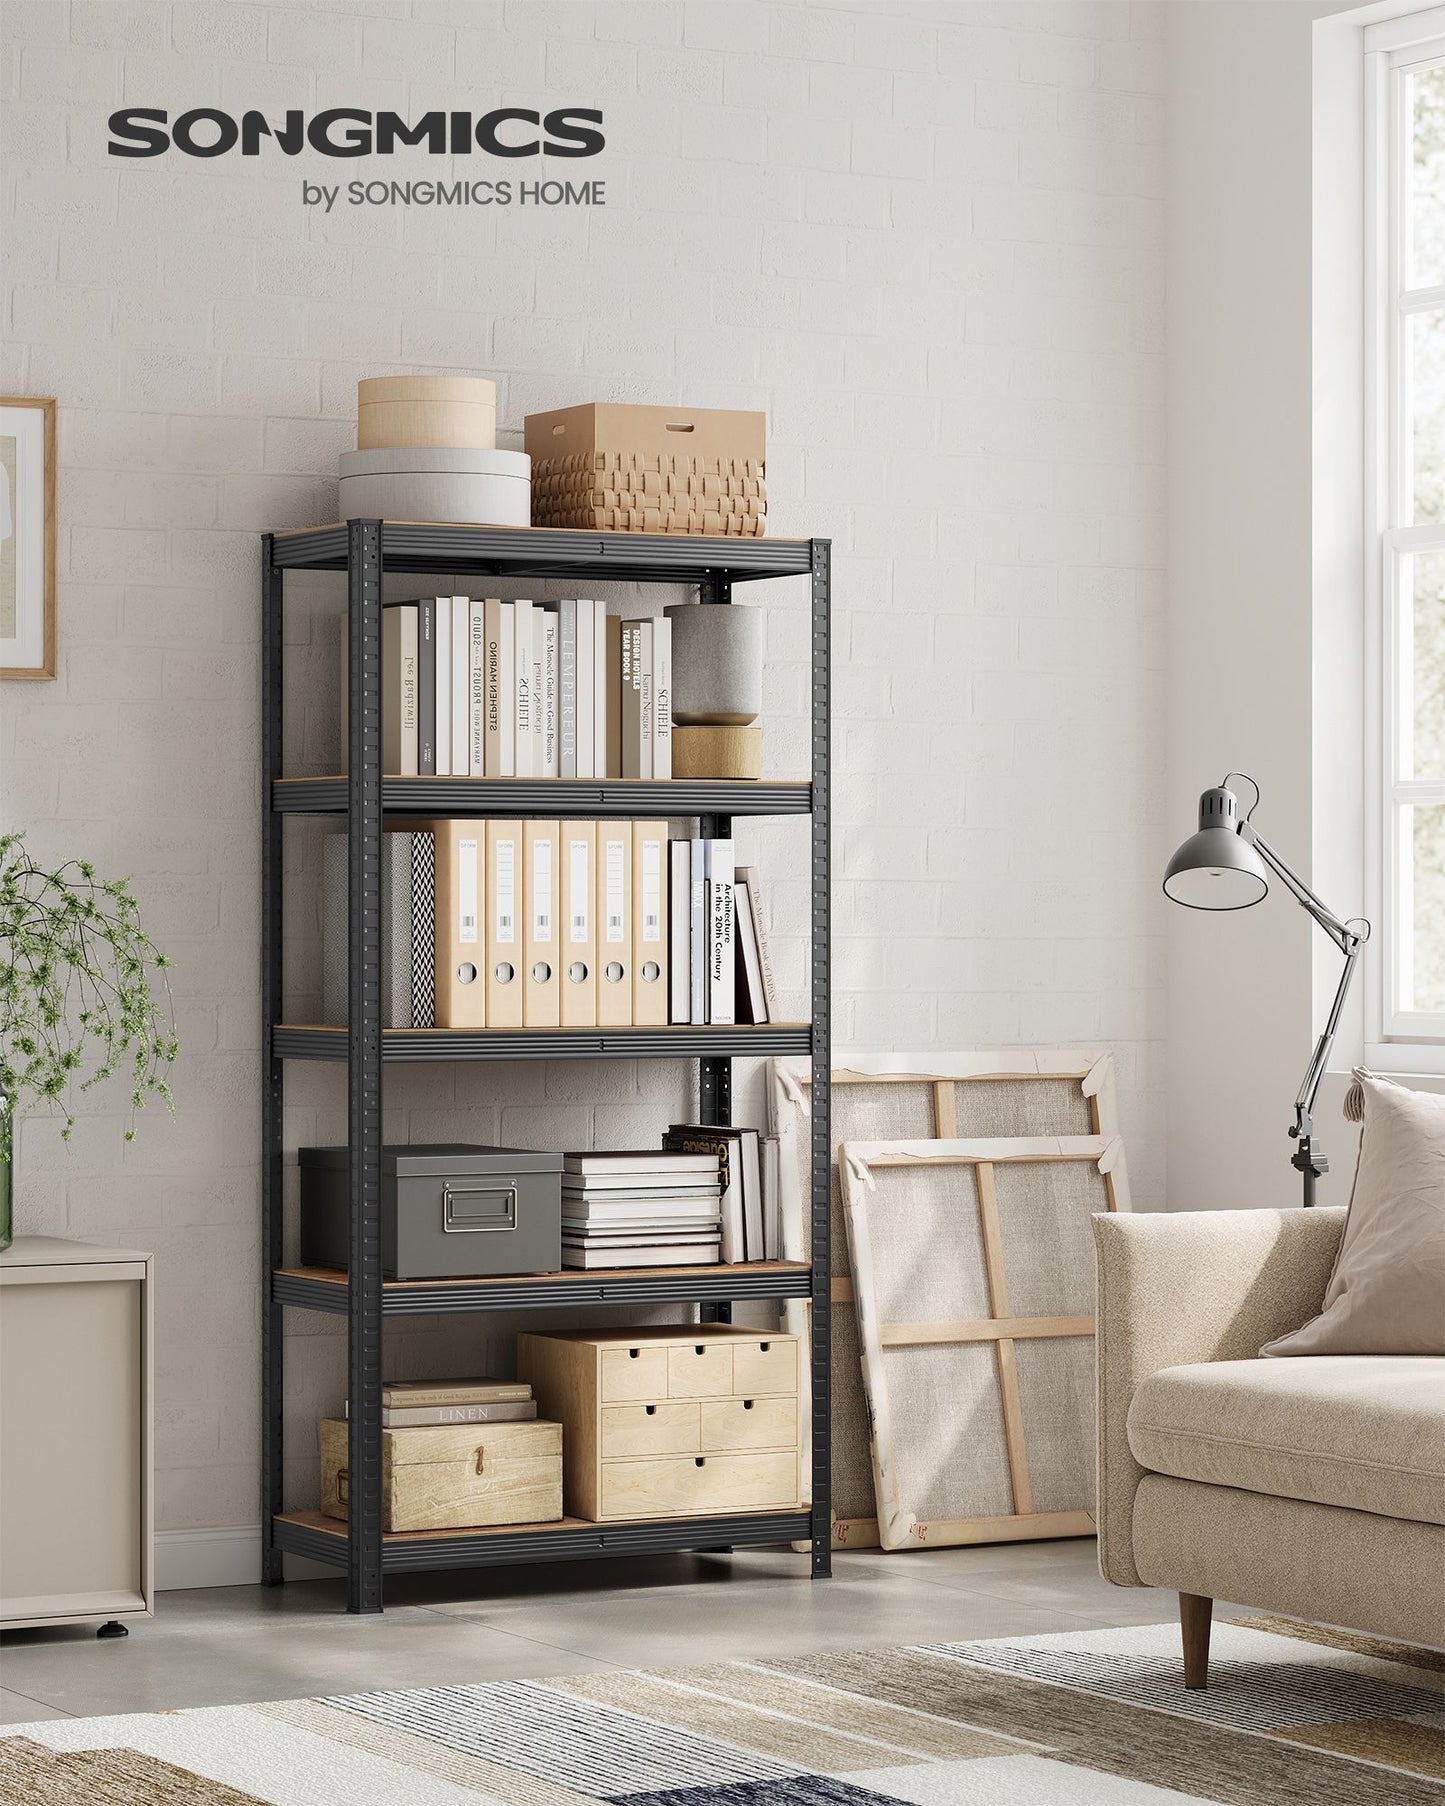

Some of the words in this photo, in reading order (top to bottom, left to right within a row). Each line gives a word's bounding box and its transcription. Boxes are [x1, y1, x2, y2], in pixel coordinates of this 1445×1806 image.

[546, 627, 555, 643] The
[623, 629, 631, 650] YEAR
[633, 629, 641, 659] DESIGN
[546, 644, 555, 676] Monocle
[623, 651, 631, 674] BOOK
[633, 660, 641, 690] HOTELS
[546, 677, 555, 700] Guide
[546, 700, 554, 709] to
[658, 688, 669, 738] SCHIELE
[546, 710, 555, 731] Good
[546, 733, 555, 764] Business
[715, 883, 724, 893] in
[715, 896, 723, 912] the
[724, 883, 732, 944] Architecture
[715, 915, 723, 939] 20th
[713, 941, 723, 982] Century
[765, 973, 776, 1003] JAPAN
[439, 1407, 488, 1421] LINEN
